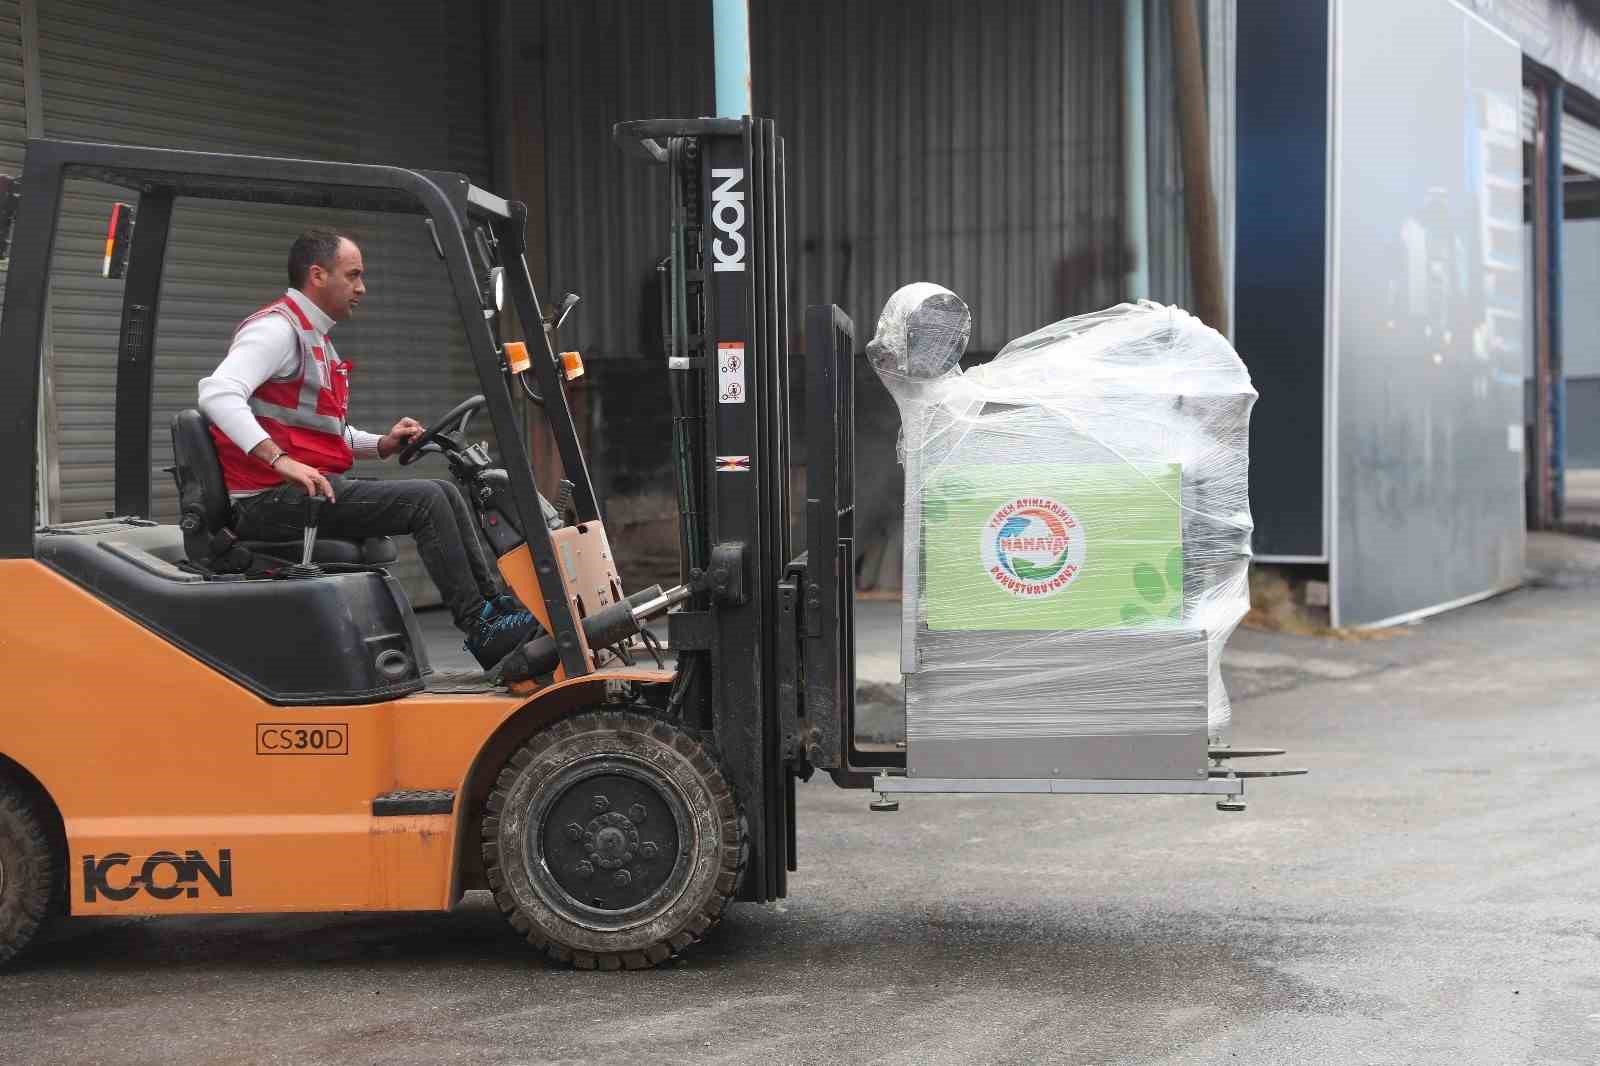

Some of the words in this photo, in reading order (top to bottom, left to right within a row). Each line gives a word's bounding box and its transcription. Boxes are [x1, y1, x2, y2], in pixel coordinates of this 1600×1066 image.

[712, 168, 745, 272] ICON
[261, 729, 343, 749] CS30D
[83, 849, 233, 903] ICON
